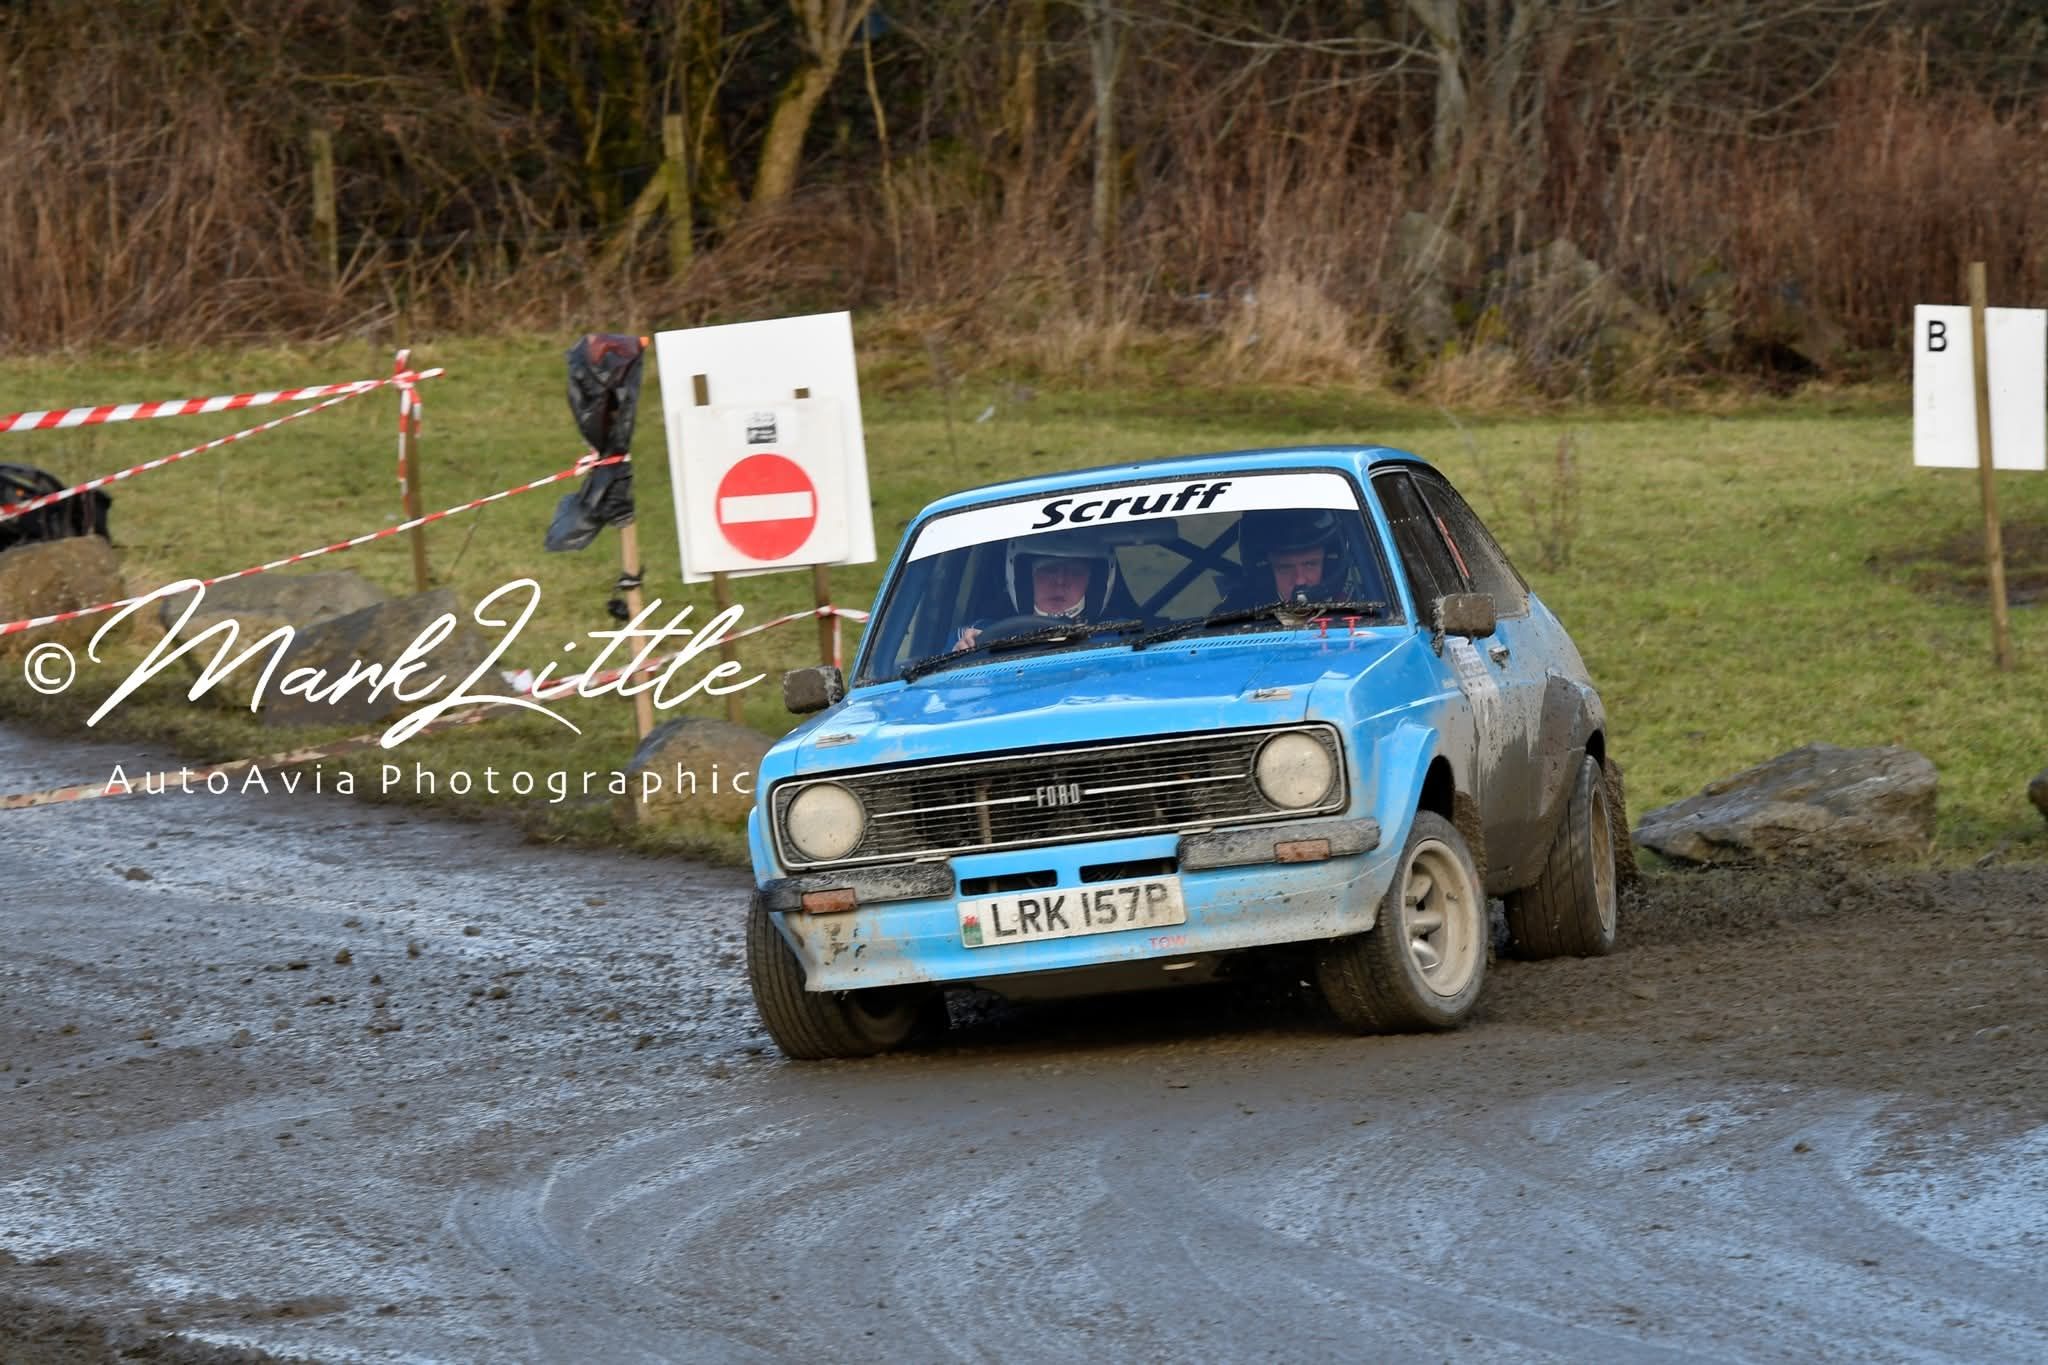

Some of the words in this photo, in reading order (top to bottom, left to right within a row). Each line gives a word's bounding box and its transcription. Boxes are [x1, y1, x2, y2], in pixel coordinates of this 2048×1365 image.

[1928, 320, 1947, 352] B
[1031, 481, 1233, 530] Scruff
[1036, 783, 1081, 808] FORD
[991, 895, 1070, 938] LRK
[1079, 882, 1169, 928] 157P
